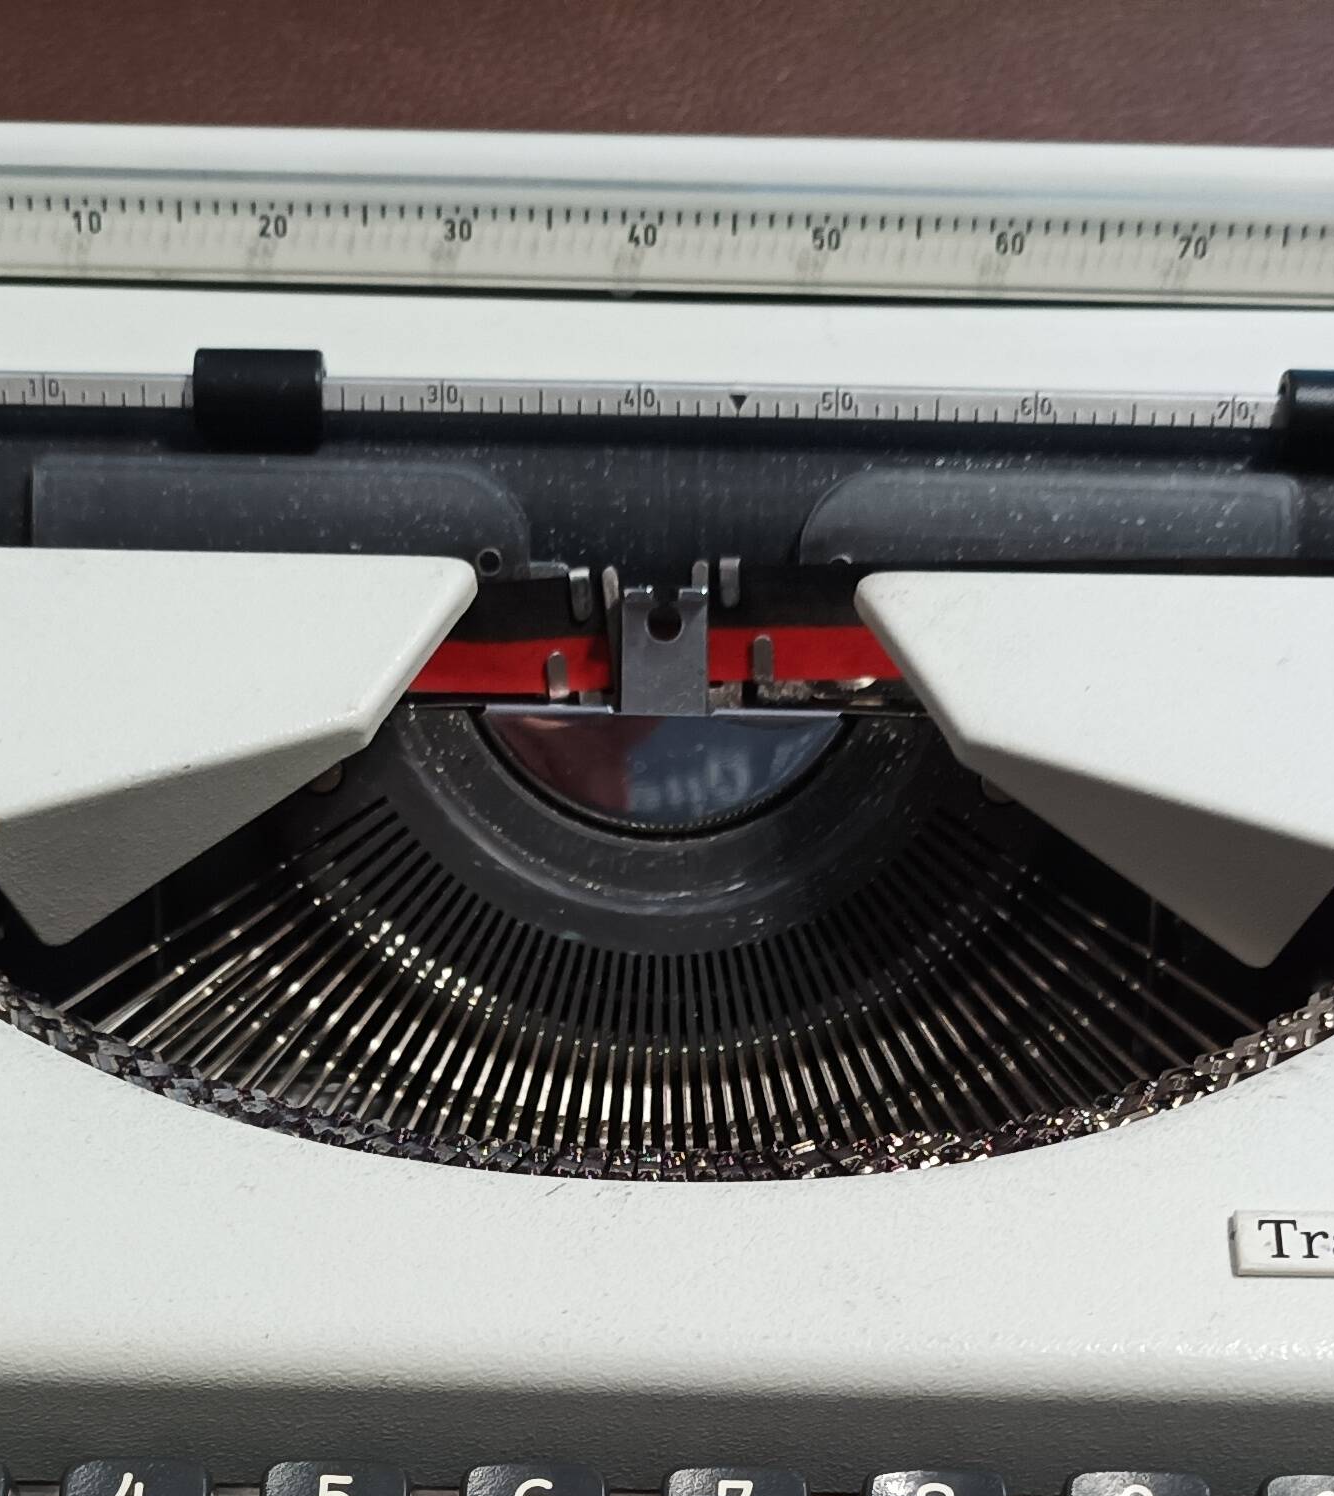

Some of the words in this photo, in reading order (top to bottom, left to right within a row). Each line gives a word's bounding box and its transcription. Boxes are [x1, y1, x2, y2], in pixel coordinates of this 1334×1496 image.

[73, 210, 102, 234] 10
[258, 215, 288, 238] 20
[444, 219, 472, 242] 30
[628, 223, 657, 247] 40
[812, 227, 841, 251] 50
[995, 231, 1025, 256] 60
[1178, 235, 1208, 259] 70
[28, 378, 60, 398] 10
[427, 385, 458, 404] 30
[624, 388, 655, 409] 40
[821, 391, 854, 412] 50
